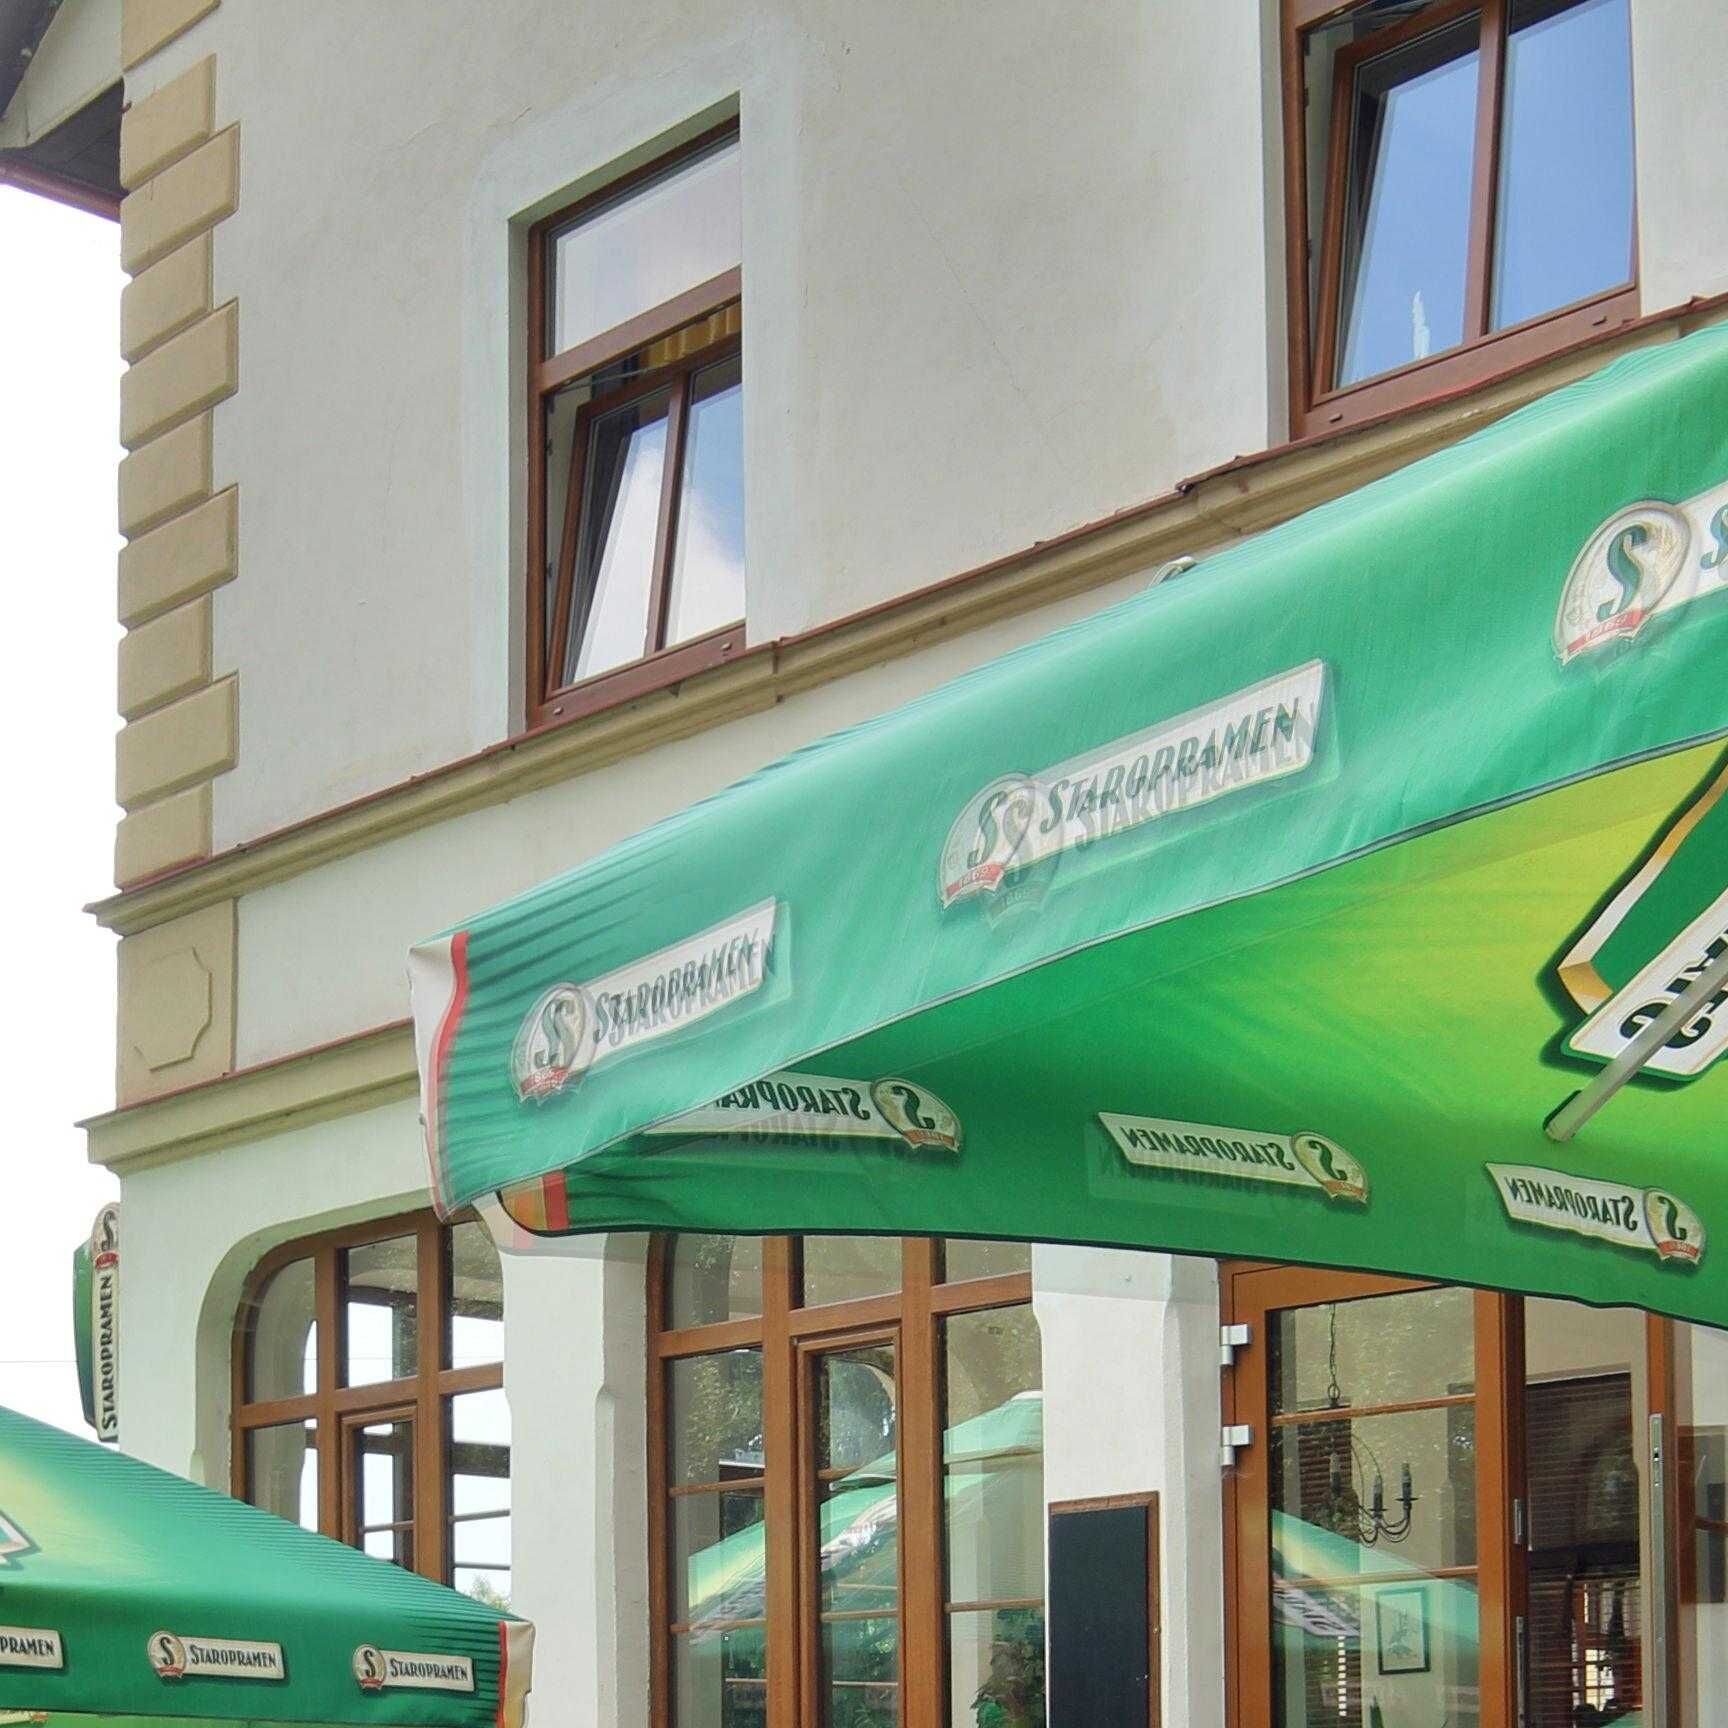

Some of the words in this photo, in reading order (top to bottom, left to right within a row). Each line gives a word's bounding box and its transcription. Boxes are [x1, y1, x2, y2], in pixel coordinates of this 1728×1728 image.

[1596, 524, 1648, 623] S
[1040, 697, 1300, 835] STAROPRAMEN
[99, 1275, 117, 1431] STAROPRAMEN
[189, 1644, 278, 1668] STAROPRAMEN
[389, 1658, 469, 1681] STAROPRAMEN
